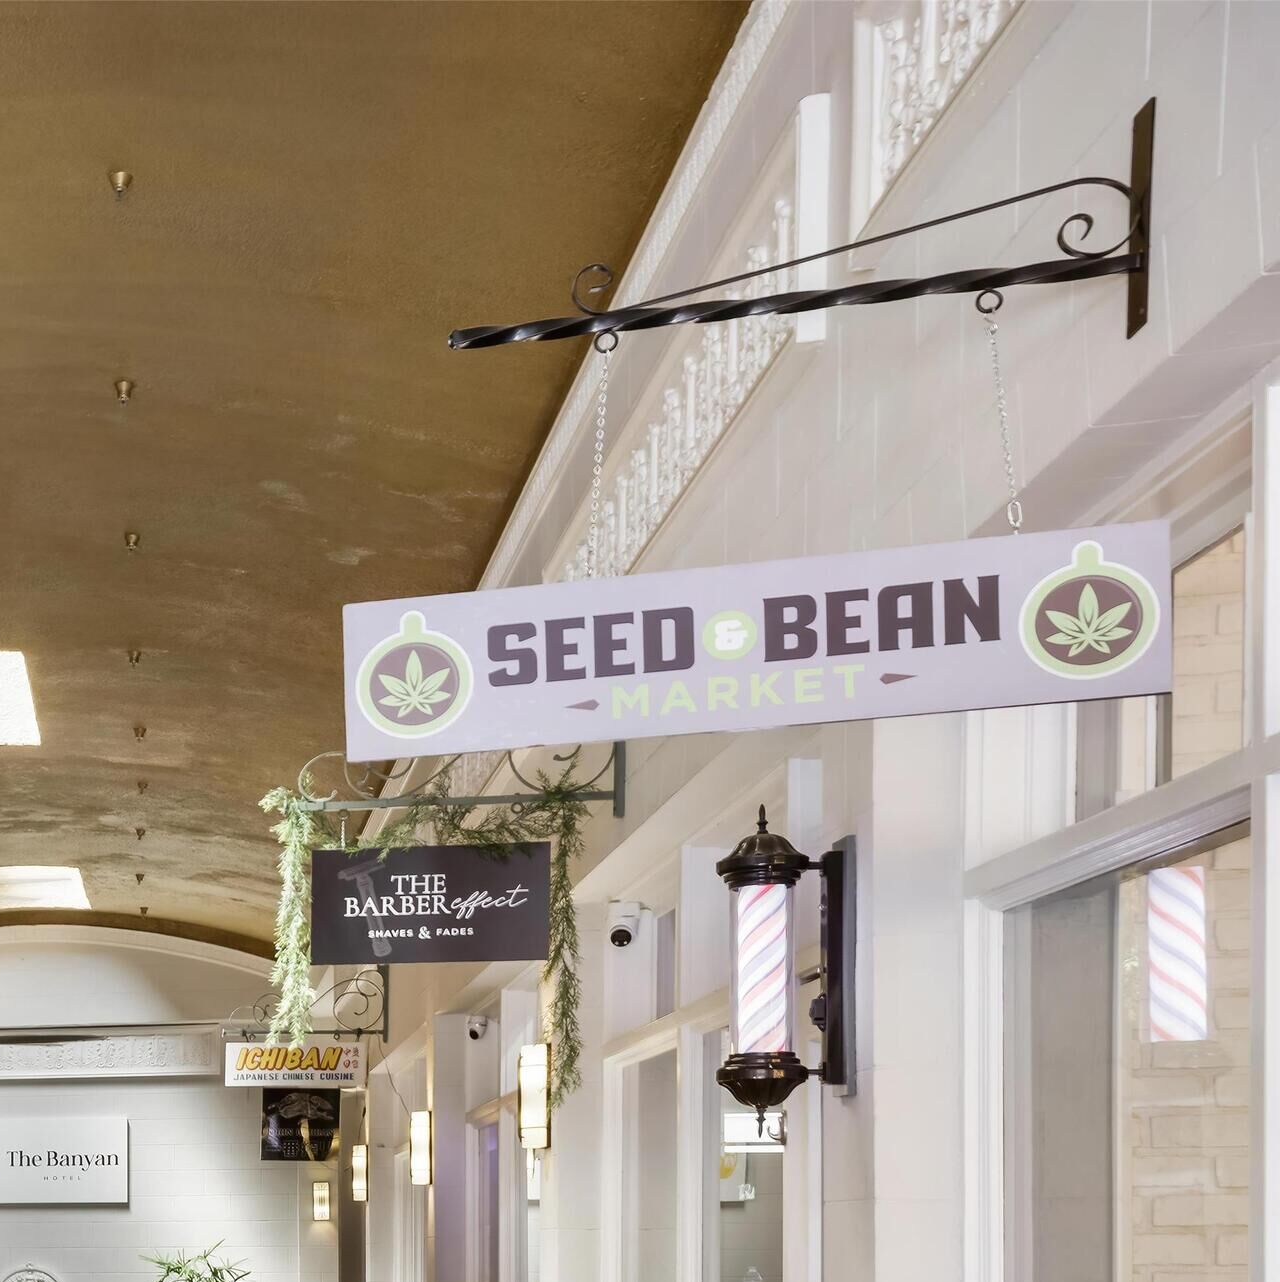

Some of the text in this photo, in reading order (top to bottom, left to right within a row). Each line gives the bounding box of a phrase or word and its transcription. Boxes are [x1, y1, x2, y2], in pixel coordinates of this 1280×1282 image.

[487, 574, 1000, 687] SEED & BEAN
[611, 664, 867, 721] MARKET
[391, 874, 446, 895] THE
[344, 884, 529, 919] BARBER effect
[368, 926, 474, 940] SHAVES & FADES
[236, 1047, 343, 1070] ICHIBAN
[7, 1151, 119, 1171] The Banyan
